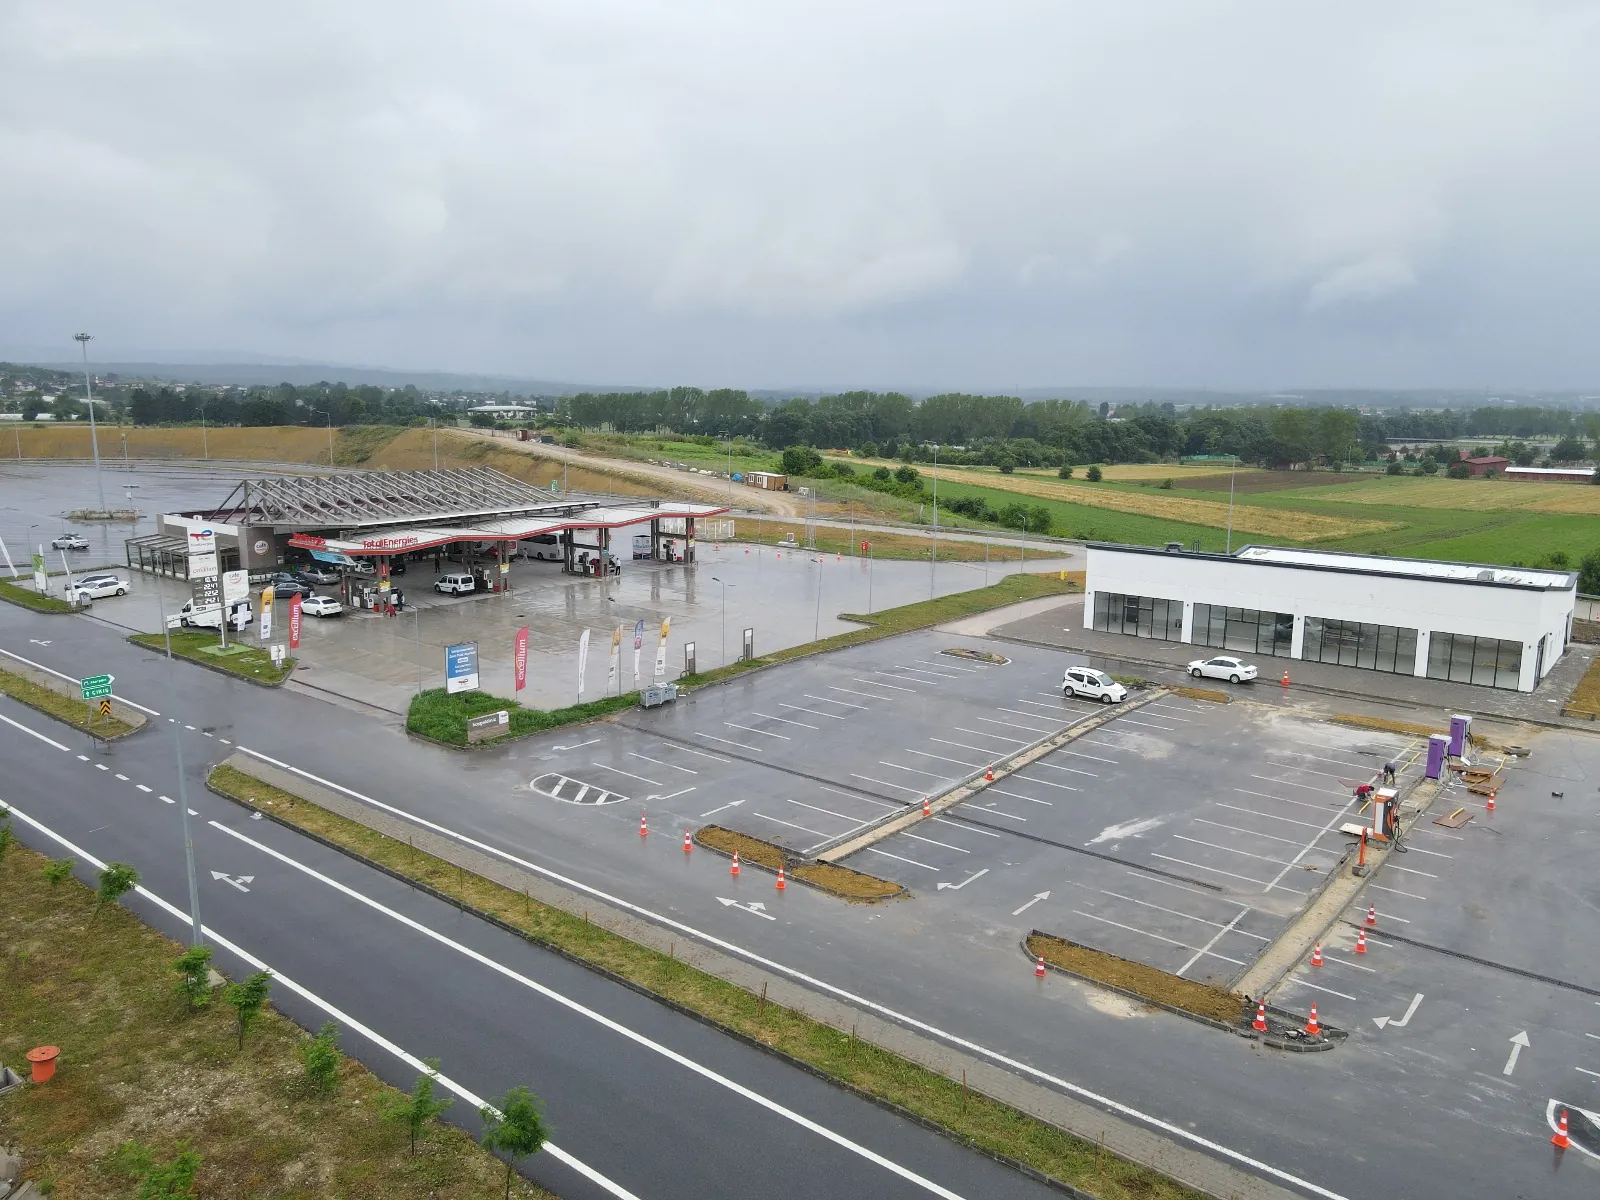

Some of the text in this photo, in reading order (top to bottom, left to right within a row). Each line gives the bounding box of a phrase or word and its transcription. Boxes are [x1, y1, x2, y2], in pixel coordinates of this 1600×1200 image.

[363, 536, 418, 549] TotalEnergies
[291, 604, 300, 641] excellium
[517, 639, 525, 680] excellium
